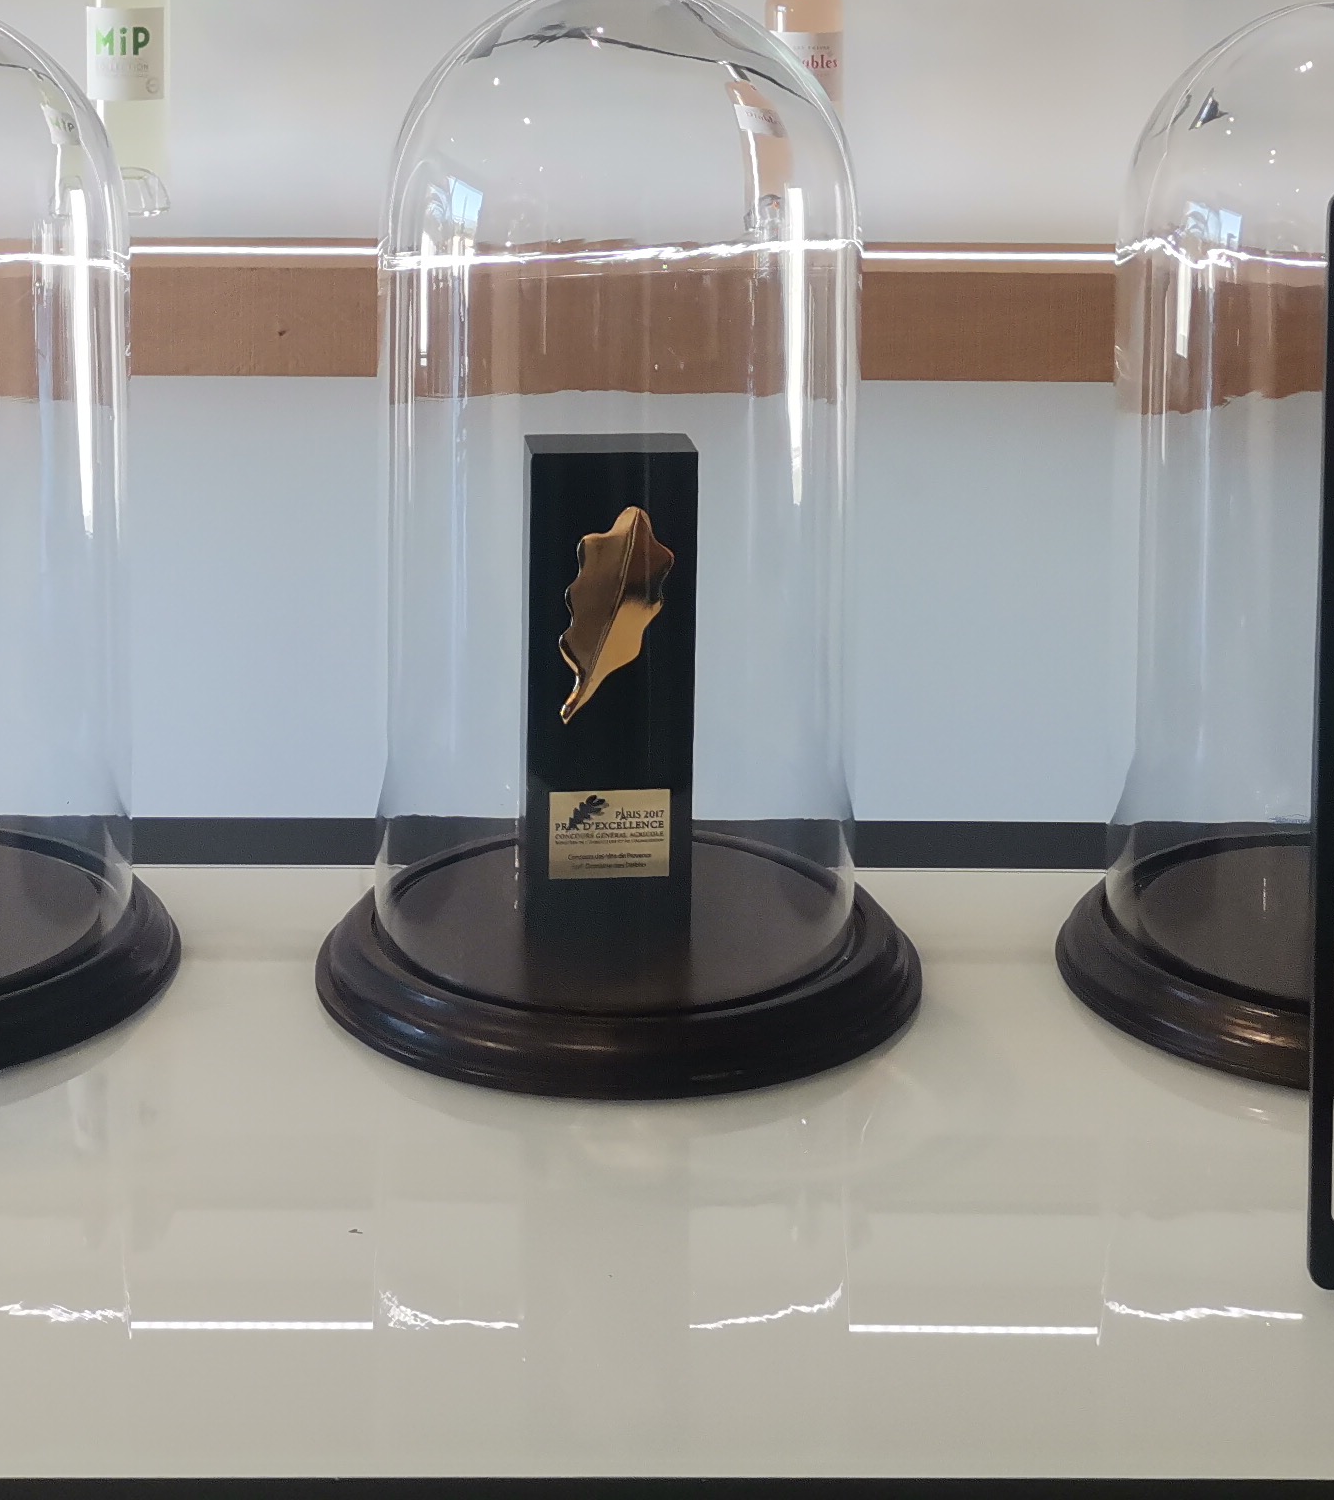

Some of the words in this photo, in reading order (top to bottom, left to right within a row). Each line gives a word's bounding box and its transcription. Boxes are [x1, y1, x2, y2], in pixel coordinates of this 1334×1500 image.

[95, 26, 150, 56] MiP
[802, 54, 838, 69] ables
[615, 807, 641, 820] PARIS
[643, 809, 665, 819] 2017
[554, 822, 579, 831] PRX
[583, 820, 665, 831] D'EXCELLENCE
